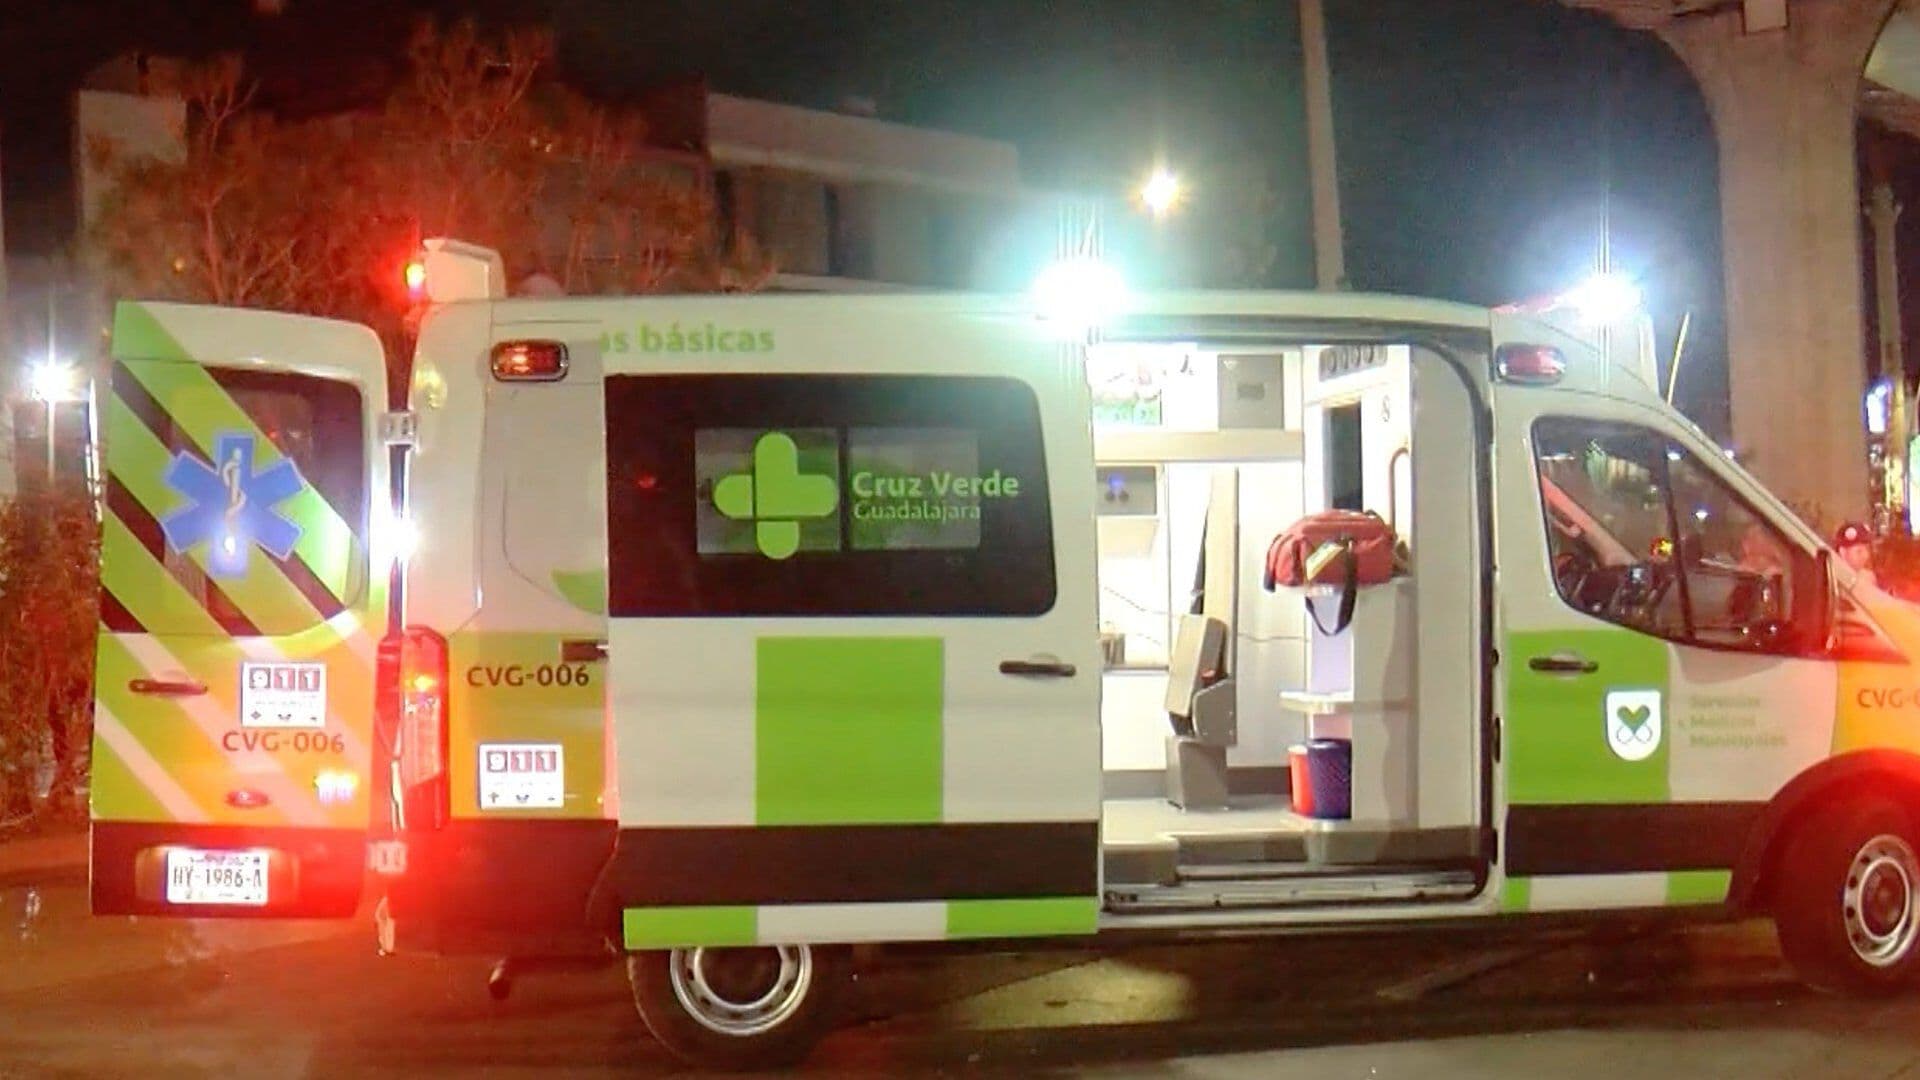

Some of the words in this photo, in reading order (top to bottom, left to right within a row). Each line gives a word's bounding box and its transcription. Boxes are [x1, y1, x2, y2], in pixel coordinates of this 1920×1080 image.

[639, 321, 776, 353] básicas
[852, 472, 922, 497] Cruz
[930, 469, 1019, 497] Verde
[853, 500, 981, 524] Guadalajara
[249, 667, 320, 692] 911
[466, 665, 590, 687] CVG-006
[222, 730, 345, 754] CVG-006
[486, 750, 557, 773] 911
